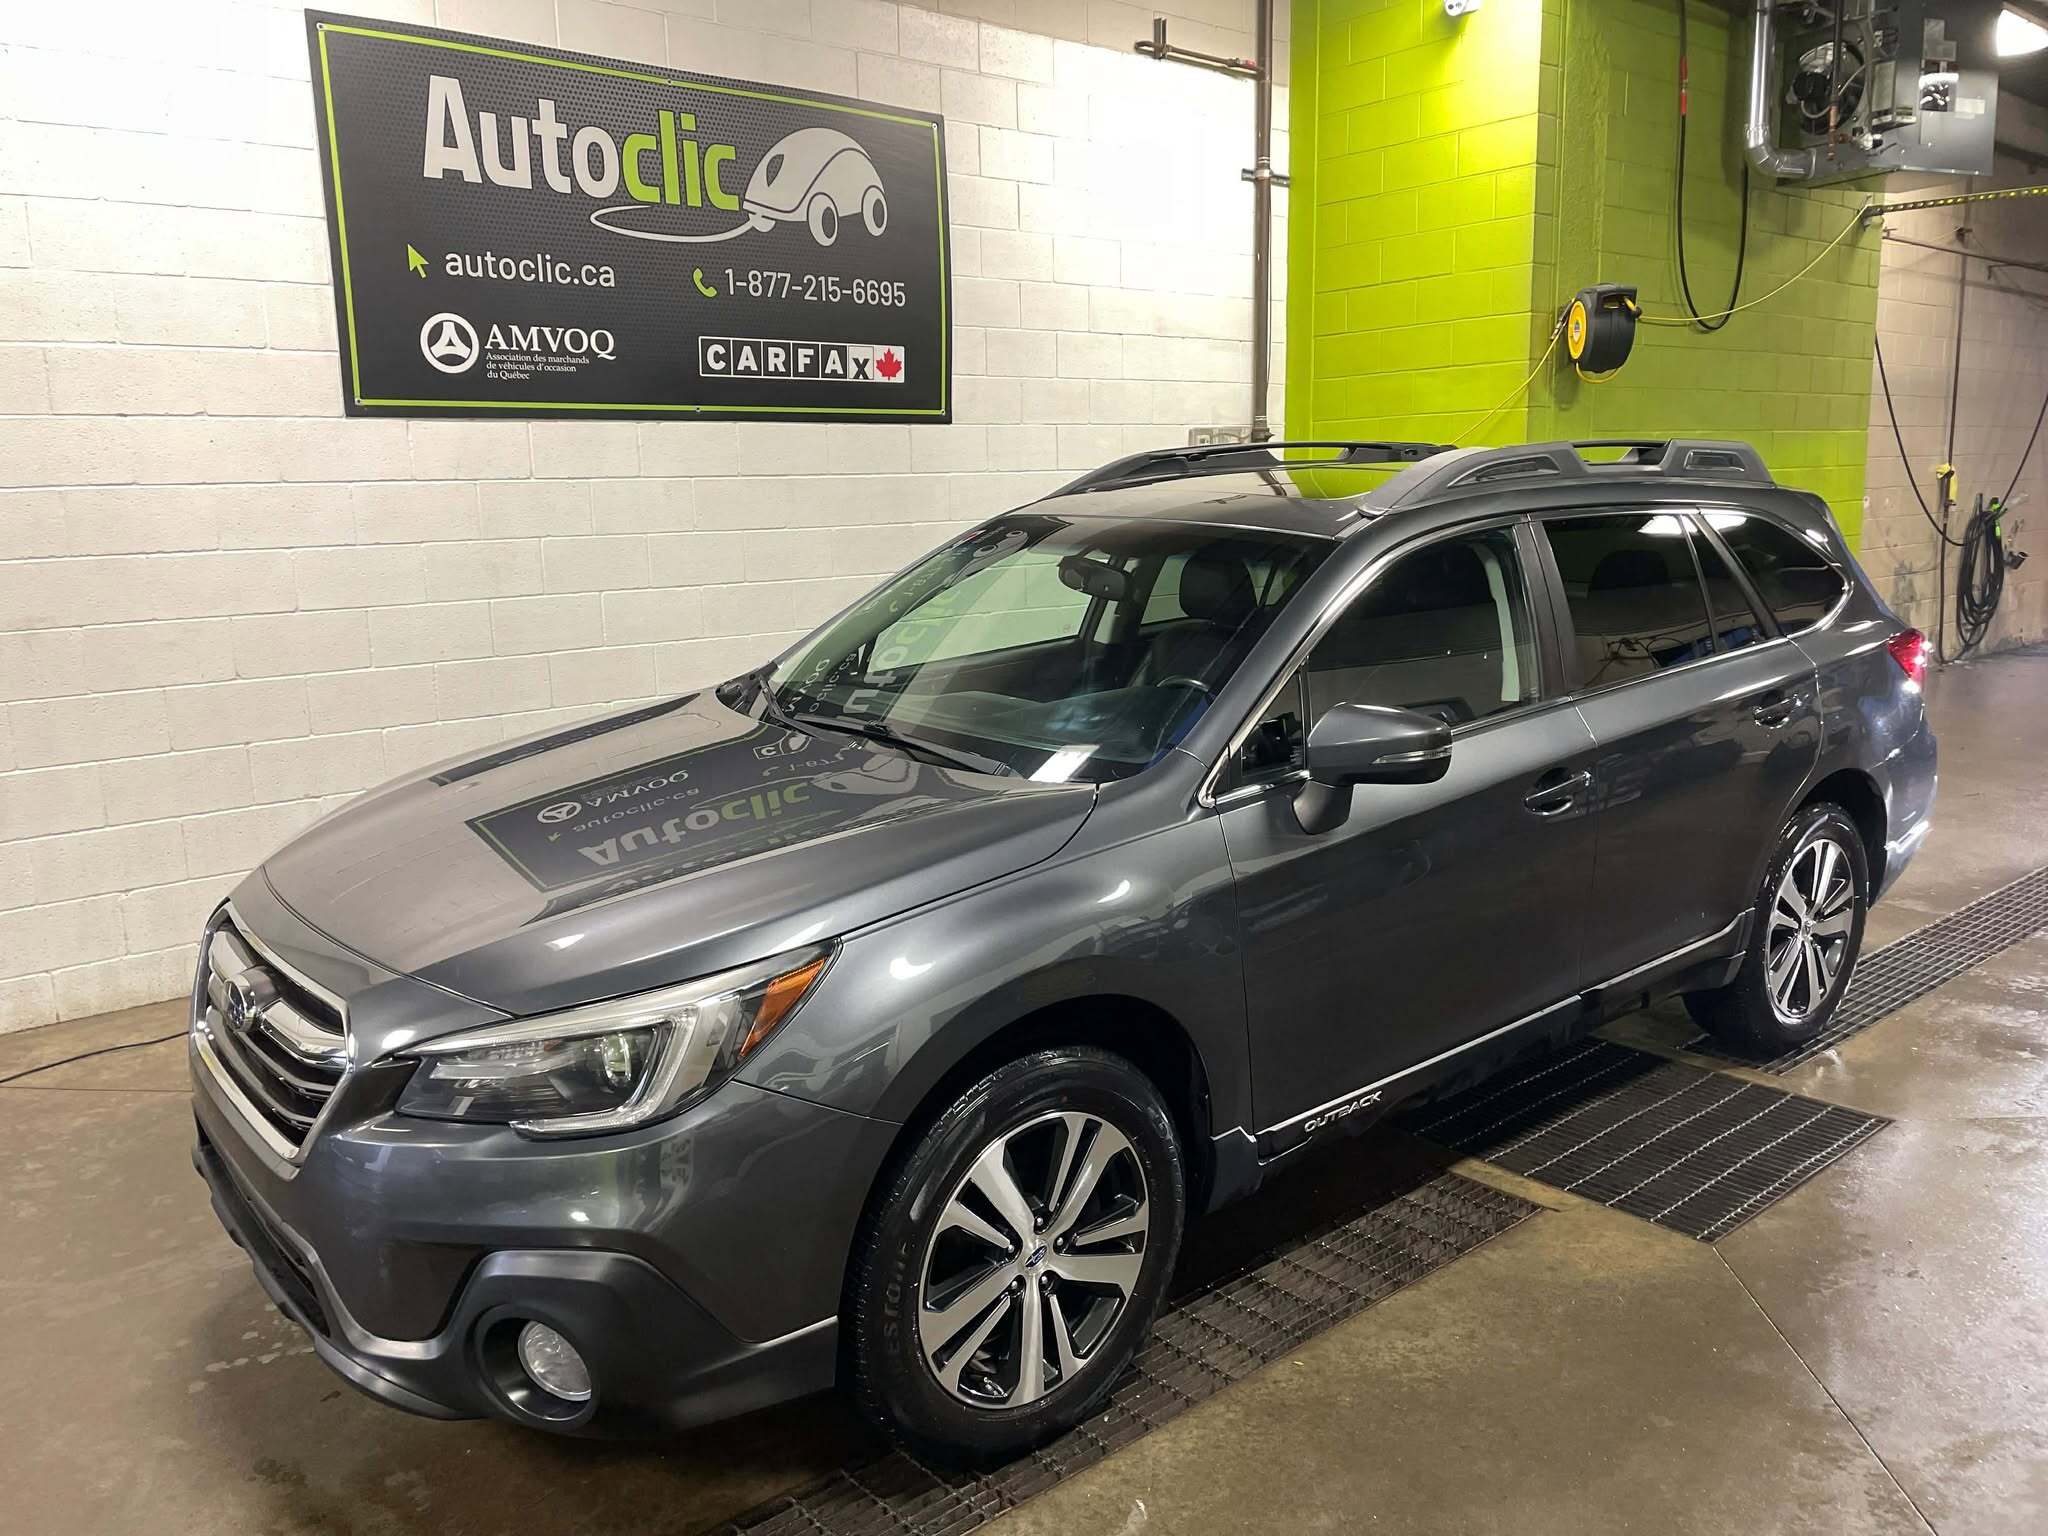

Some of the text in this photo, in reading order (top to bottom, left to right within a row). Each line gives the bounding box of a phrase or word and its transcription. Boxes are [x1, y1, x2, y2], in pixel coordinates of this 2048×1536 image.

[423, 75, 740, 211] Autoclic
[445, 251, 616, 287] autoclic.ca
[725, 268, 906, 307] 1-877-215-6695
[484, 323, 617, 360] AMVOQ
[486, 352, 590, 364] Association des marchands
[486, 361, 497, 370] de
[498, 362, 535, 371] véhicules
[487, 370, 530, 381] du Québec
[705, 343, 871, 380] CARFAX
[1304, 1090, 1382, 1133] OUTBACK
